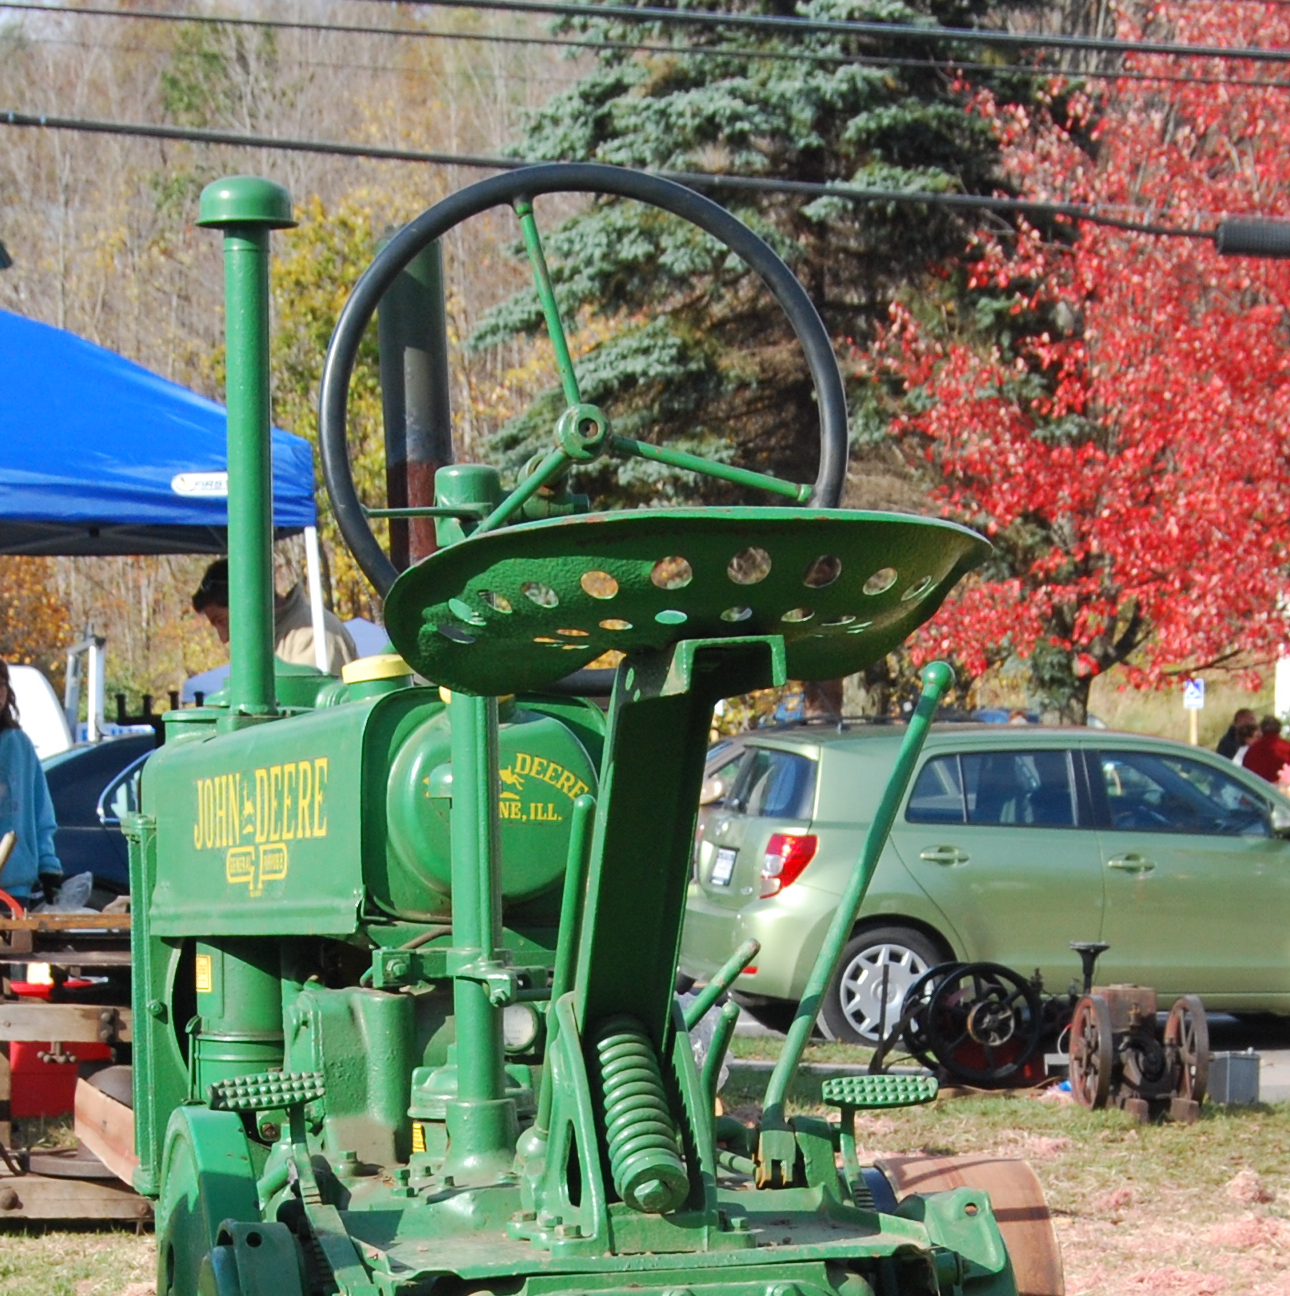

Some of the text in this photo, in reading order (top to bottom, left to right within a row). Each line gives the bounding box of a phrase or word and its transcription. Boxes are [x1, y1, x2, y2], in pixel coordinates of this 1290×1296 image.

[514, 752, 590, 801] DEERE
[193, 756, 328, 850] JOHN DEERE
[529, 803, 563, 821] ILL.
